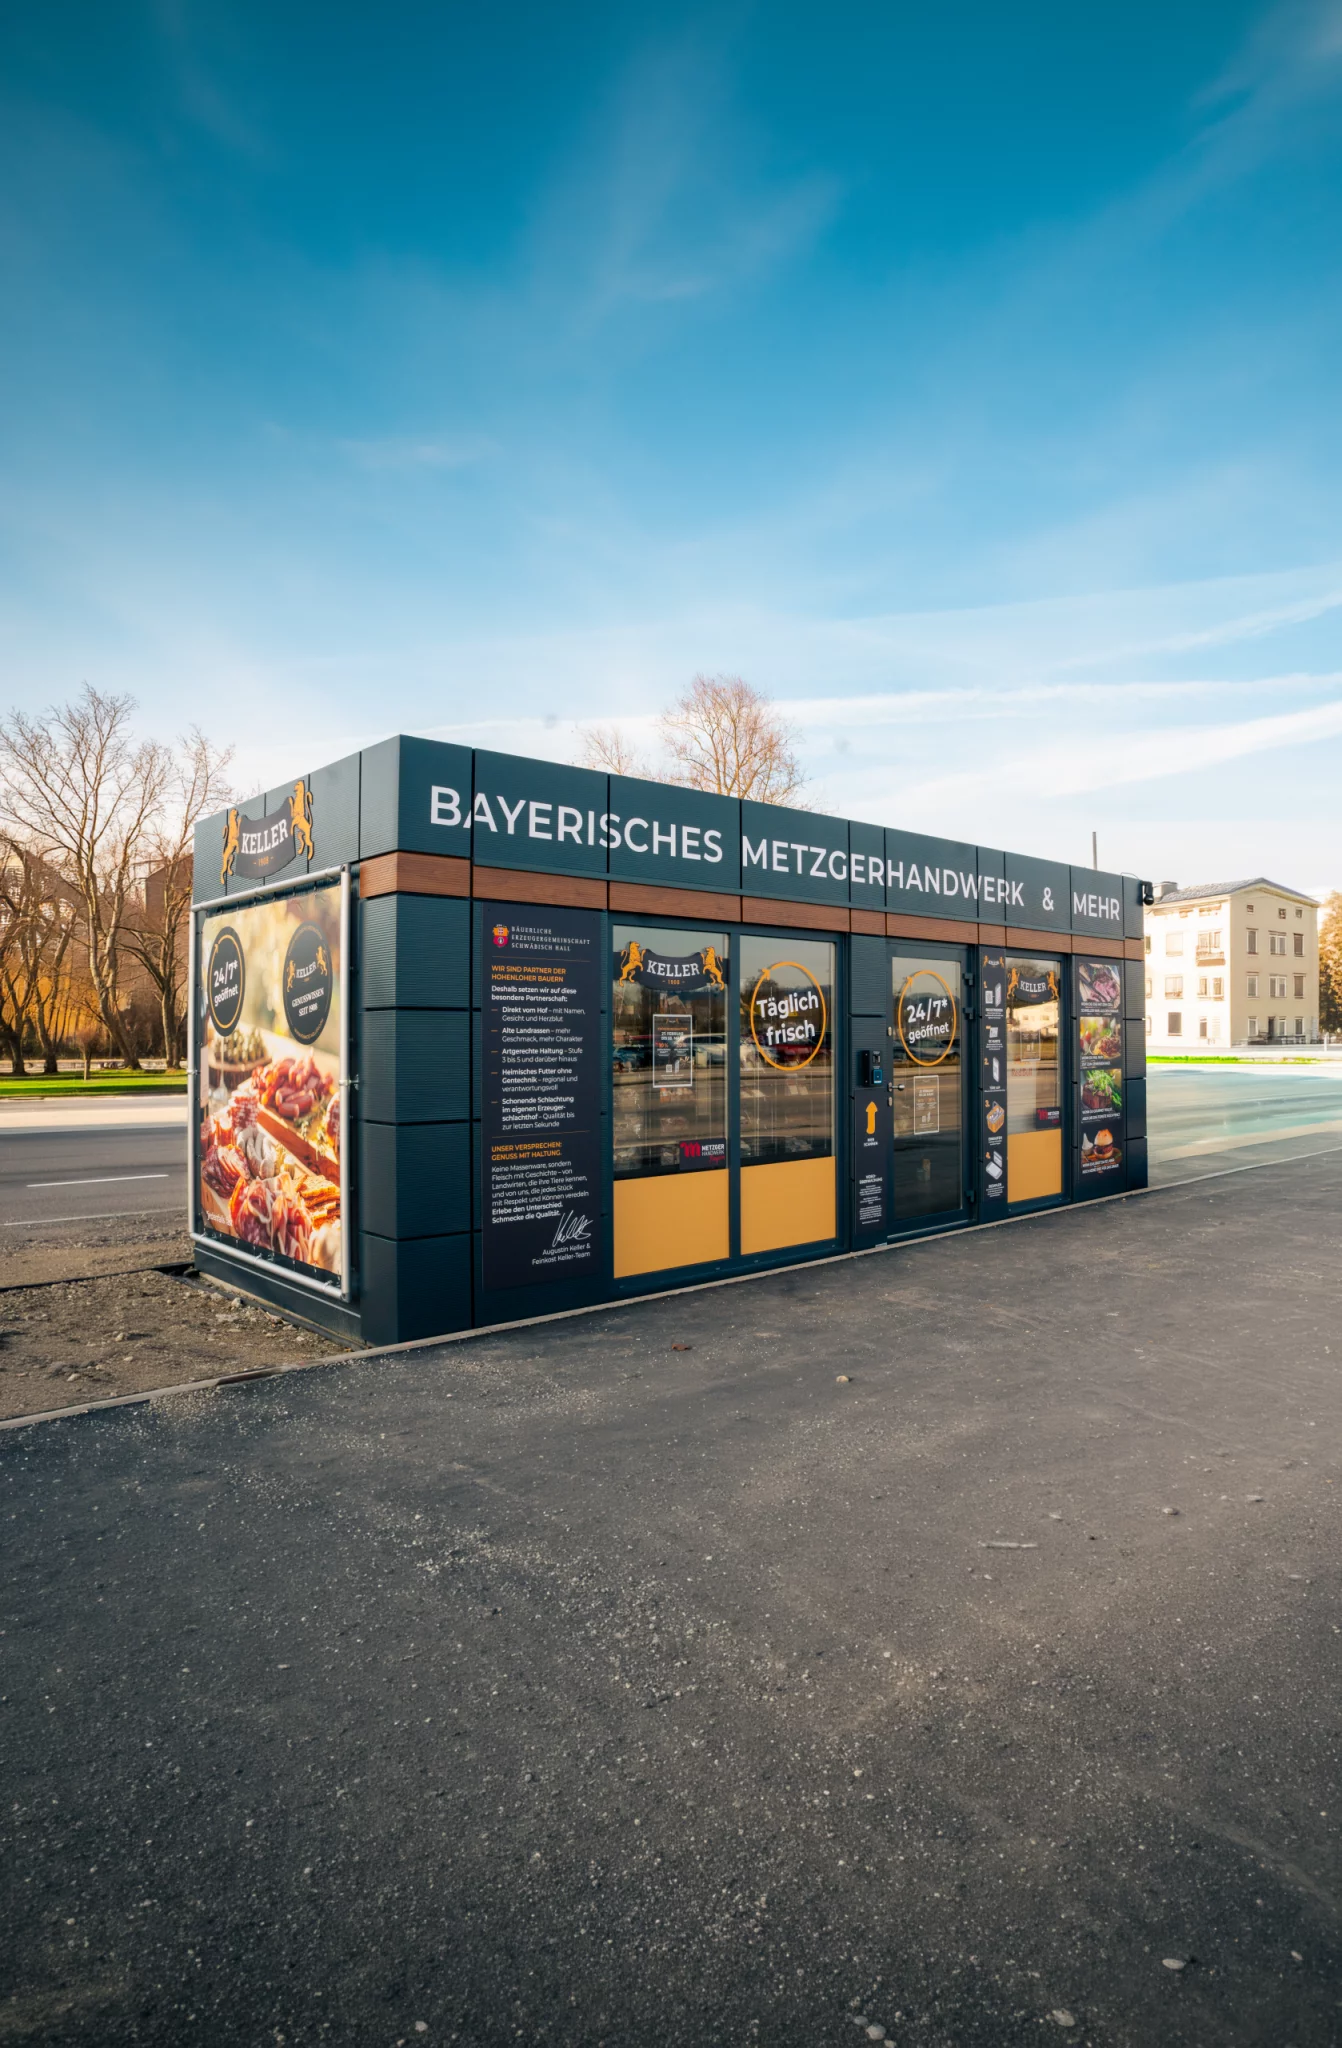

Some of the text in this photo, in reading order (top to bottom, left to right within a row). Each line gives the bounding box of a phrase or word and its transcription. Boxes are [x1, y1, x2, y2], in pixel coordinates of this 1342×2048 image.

[241, 819, 288, 854] KELLER
[430, 785, 1120, 921] BAYERISCHES METZGERHANDWERK & MEHR
[512, 926, 552, 934] BÄUERLICHE
[512, 935, 590, 944] ERZEUGERGEMEINSCHAFT
[296, 961, 317, 979] KELLER
[647, 960, 700, 977] KELLER
[1020, 980, 1047, 992] KELLER
[214, 984, 238, 1007] geöffnet
[292, 987, 324, 1008] GENUSSWISSEN
[298, 1006, 308, 1016] SEIT
[756, 991, 819, 1019] Täglich
[766, 1020, 816, 1046] frisch
[908, 1022, 949, 1044] geöffnet
[502, 1084, 558, 1092] verantwortungsvoll
[512, 1106, 536, 1114] eigenen
[515, 1142, 562, 1151] VERSPRECHEN:
[510, 1163, 547, 1171] Massenware,
[525, 1170, 557, 1178] Geschichte
[492, 1181, 527, 1190] Landwirten,
[504, 1197, 528, 1207] Respekt
[565, 1191, 589, 1199] veredeln
[526, 1201, 563, 1211] Unterschied.
[492, 1216, 524, 1224] Schmecke
[536, 1210, 561, 1219] Qualität.
[542, 1246, 568, 1255] Augustin
[532, 1252, 590, 1265] Feinkost Keller-Team
